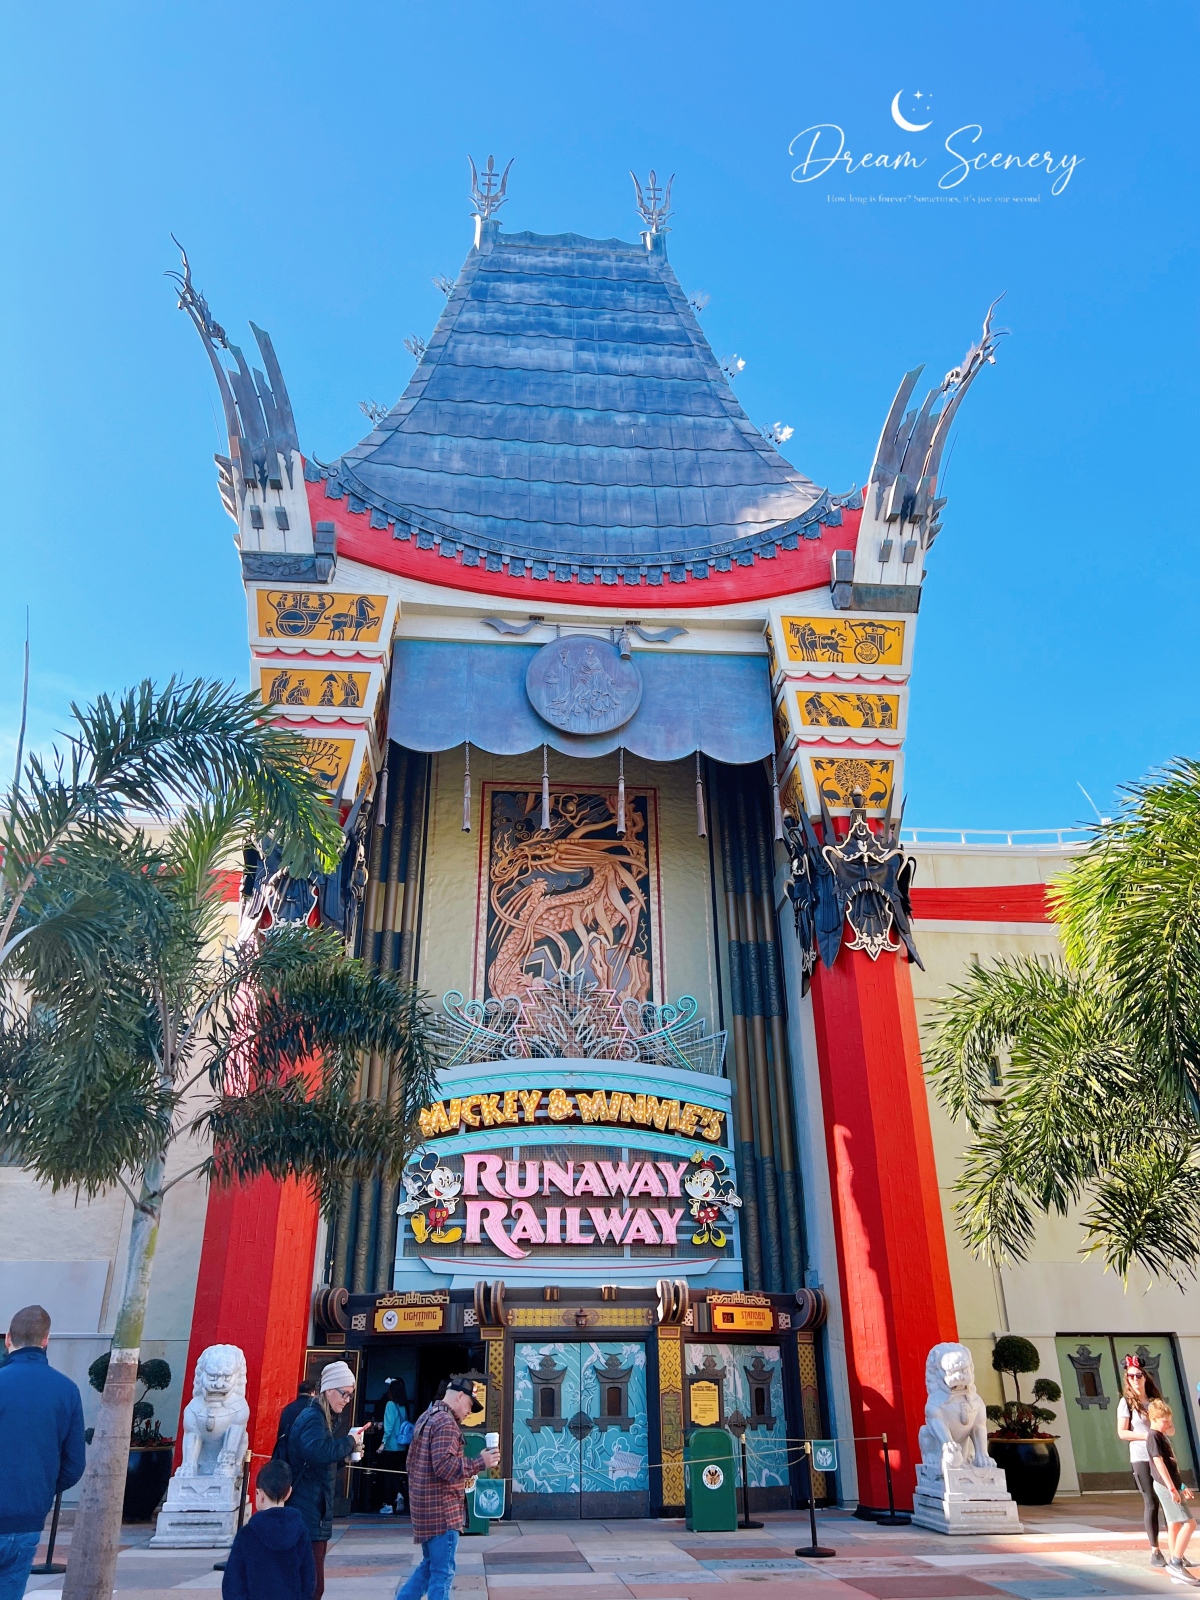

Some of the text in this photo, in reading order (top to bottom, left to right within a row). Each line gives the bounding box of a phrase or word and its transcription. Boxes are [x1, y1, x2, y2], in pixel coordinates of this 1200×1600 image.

[418, 1088, 725, 1142] MICKEY & MINNIE'S
[461, 1153, 690, 1200] RUNAWAY
[463, 1200, 686, 1260] RAILWAY
